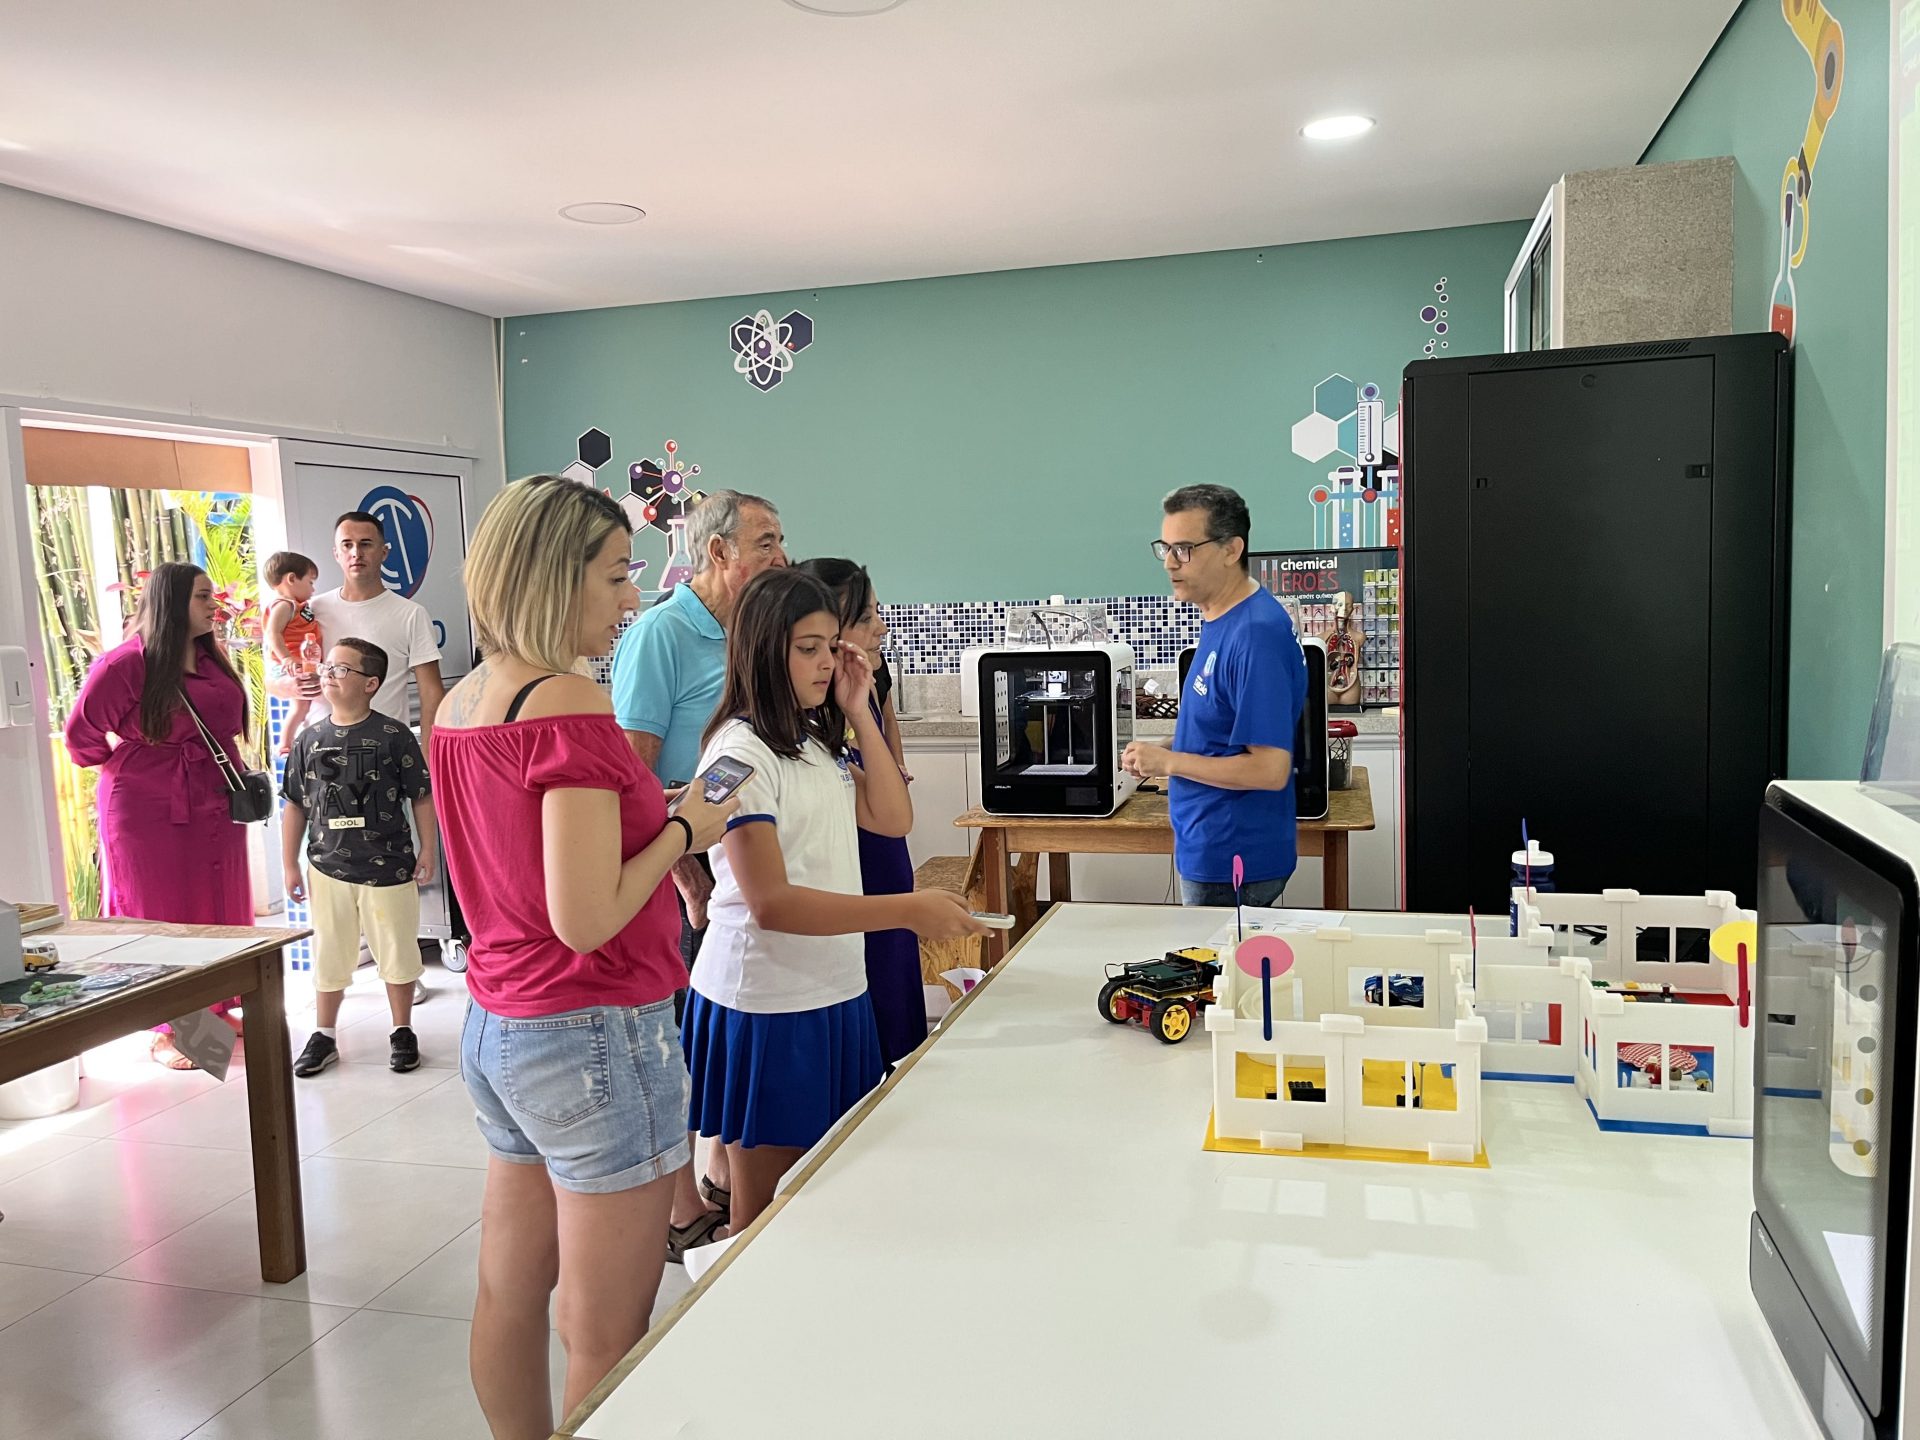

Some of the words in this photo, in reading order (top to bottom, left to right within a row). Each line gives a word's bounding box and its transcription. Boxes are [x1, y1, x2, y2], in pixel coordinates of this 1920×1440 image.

[1280, 556, 1338, 571] chemical
[1260, 559, 1339, 594] HEROES
[334, 819, 359, 827] COOL
